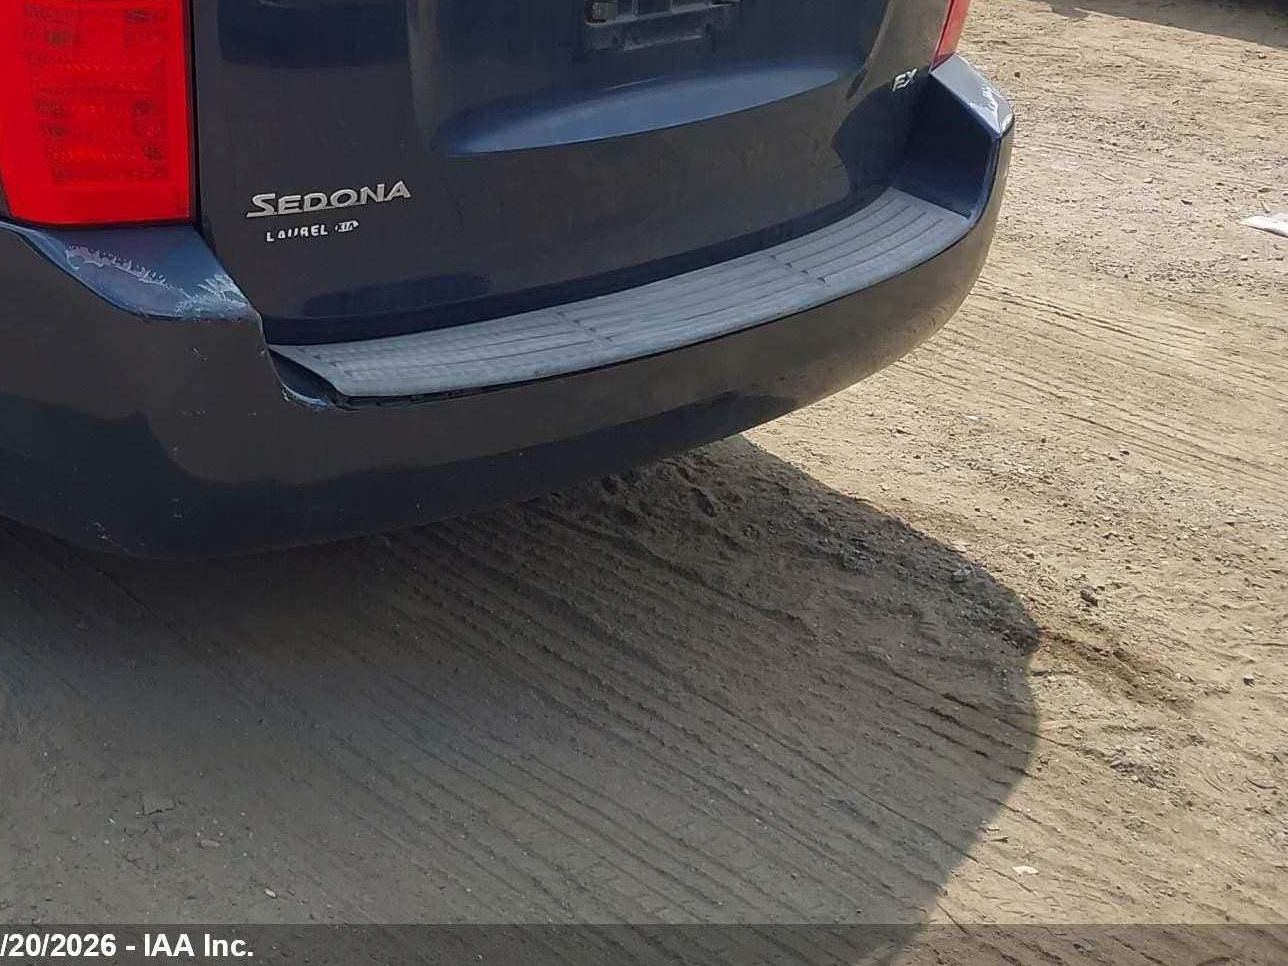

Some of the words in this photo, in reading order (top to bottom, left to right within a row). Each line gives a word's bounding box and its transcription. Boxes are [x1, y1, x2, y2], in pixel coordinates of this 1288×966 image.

[892, 68, 918, 92] EX
[246, 180, 411, 218] SEDONA
[266, 223, 328, 242] LAUREL
